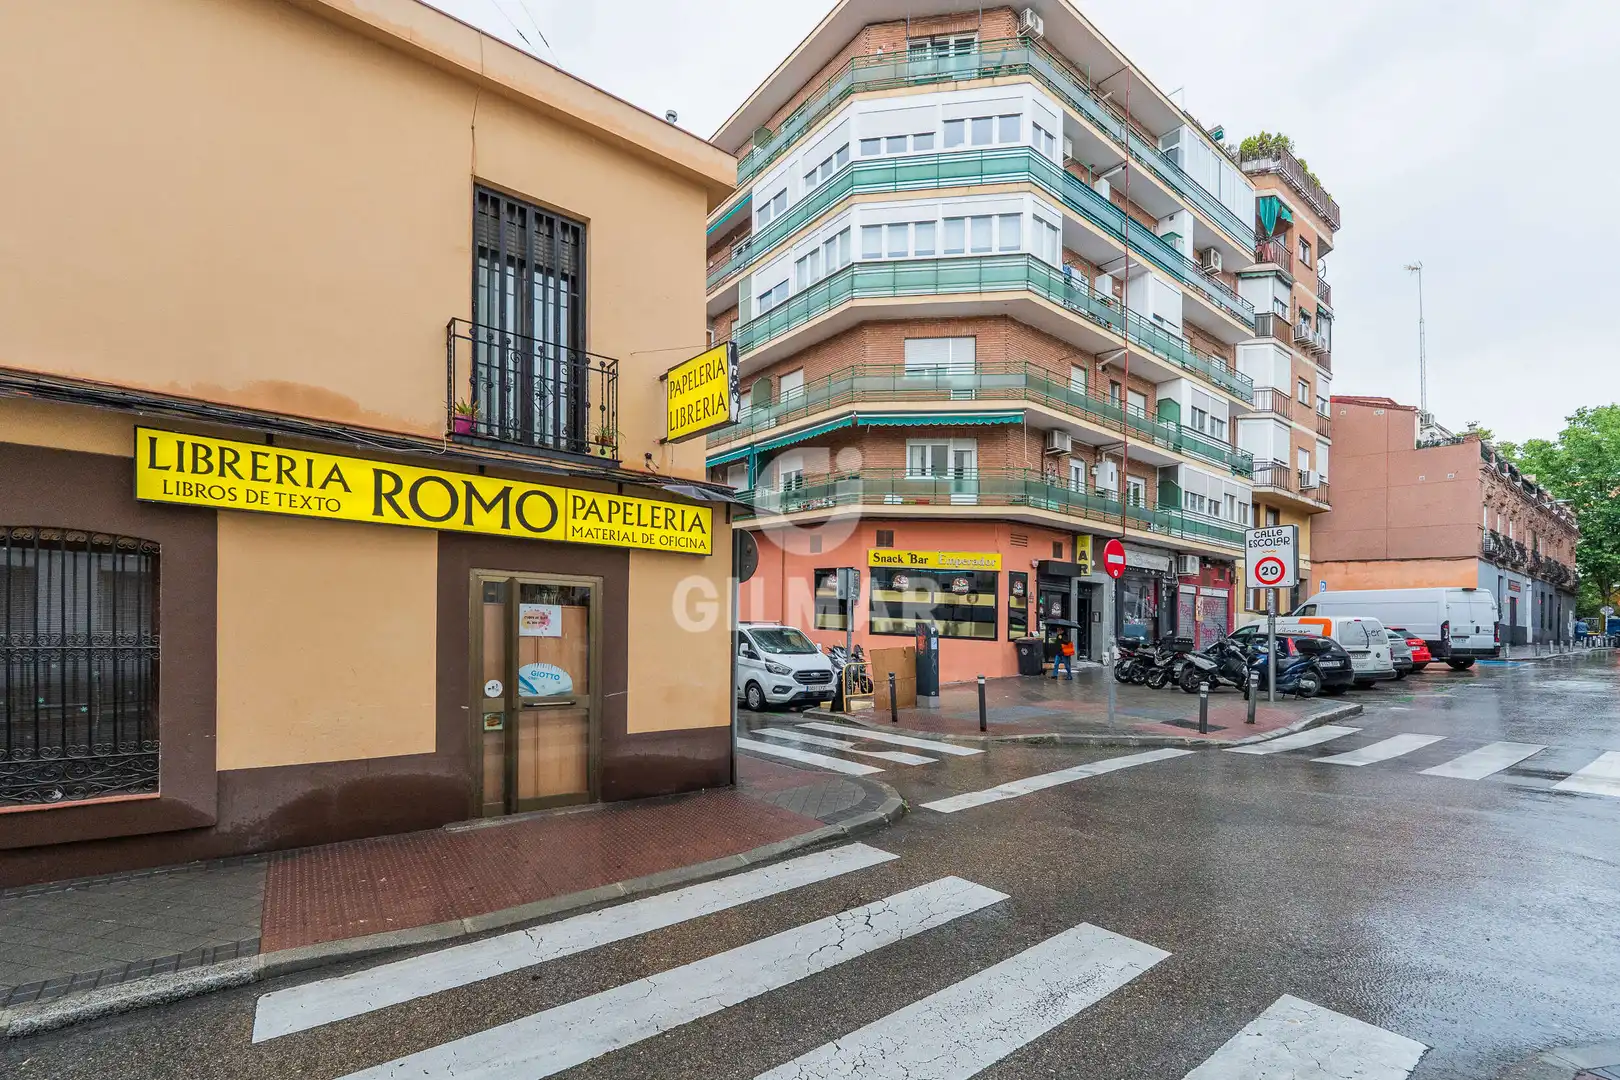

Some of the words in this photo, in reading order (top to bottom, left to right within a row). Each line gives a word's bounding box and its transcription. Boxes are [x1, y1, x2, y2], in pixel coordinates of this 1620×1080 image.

[670, 357, 725, 399] PAPELERIA
[670, 392, 726, 431] LIBRERIA
[147, 436, 353, 494] LIBRERIA
[162, 479, 238, 502] LIBROS
[245, 488, 270, 505] DE
[273, 491, 342, 513] TEXTO
[372, 468, 558, 533] ROMO
[572, 495, 706, 534] PAPELERIA
[571, 525, 638, 544] MATERIAL
[641, 532, 655, 545] DE
[658, 534, 707, 550] OFICINA
[1248, 537, 1291, 548] ESCOLAR
[873, 552, 904, 564] Snack
[907, 552, 929, 565] Bar
[937, 553, 997, 568] Emperador
[1261, 566, 1279, 576] 20
[531, 670, 560, 681] GIOTTO
